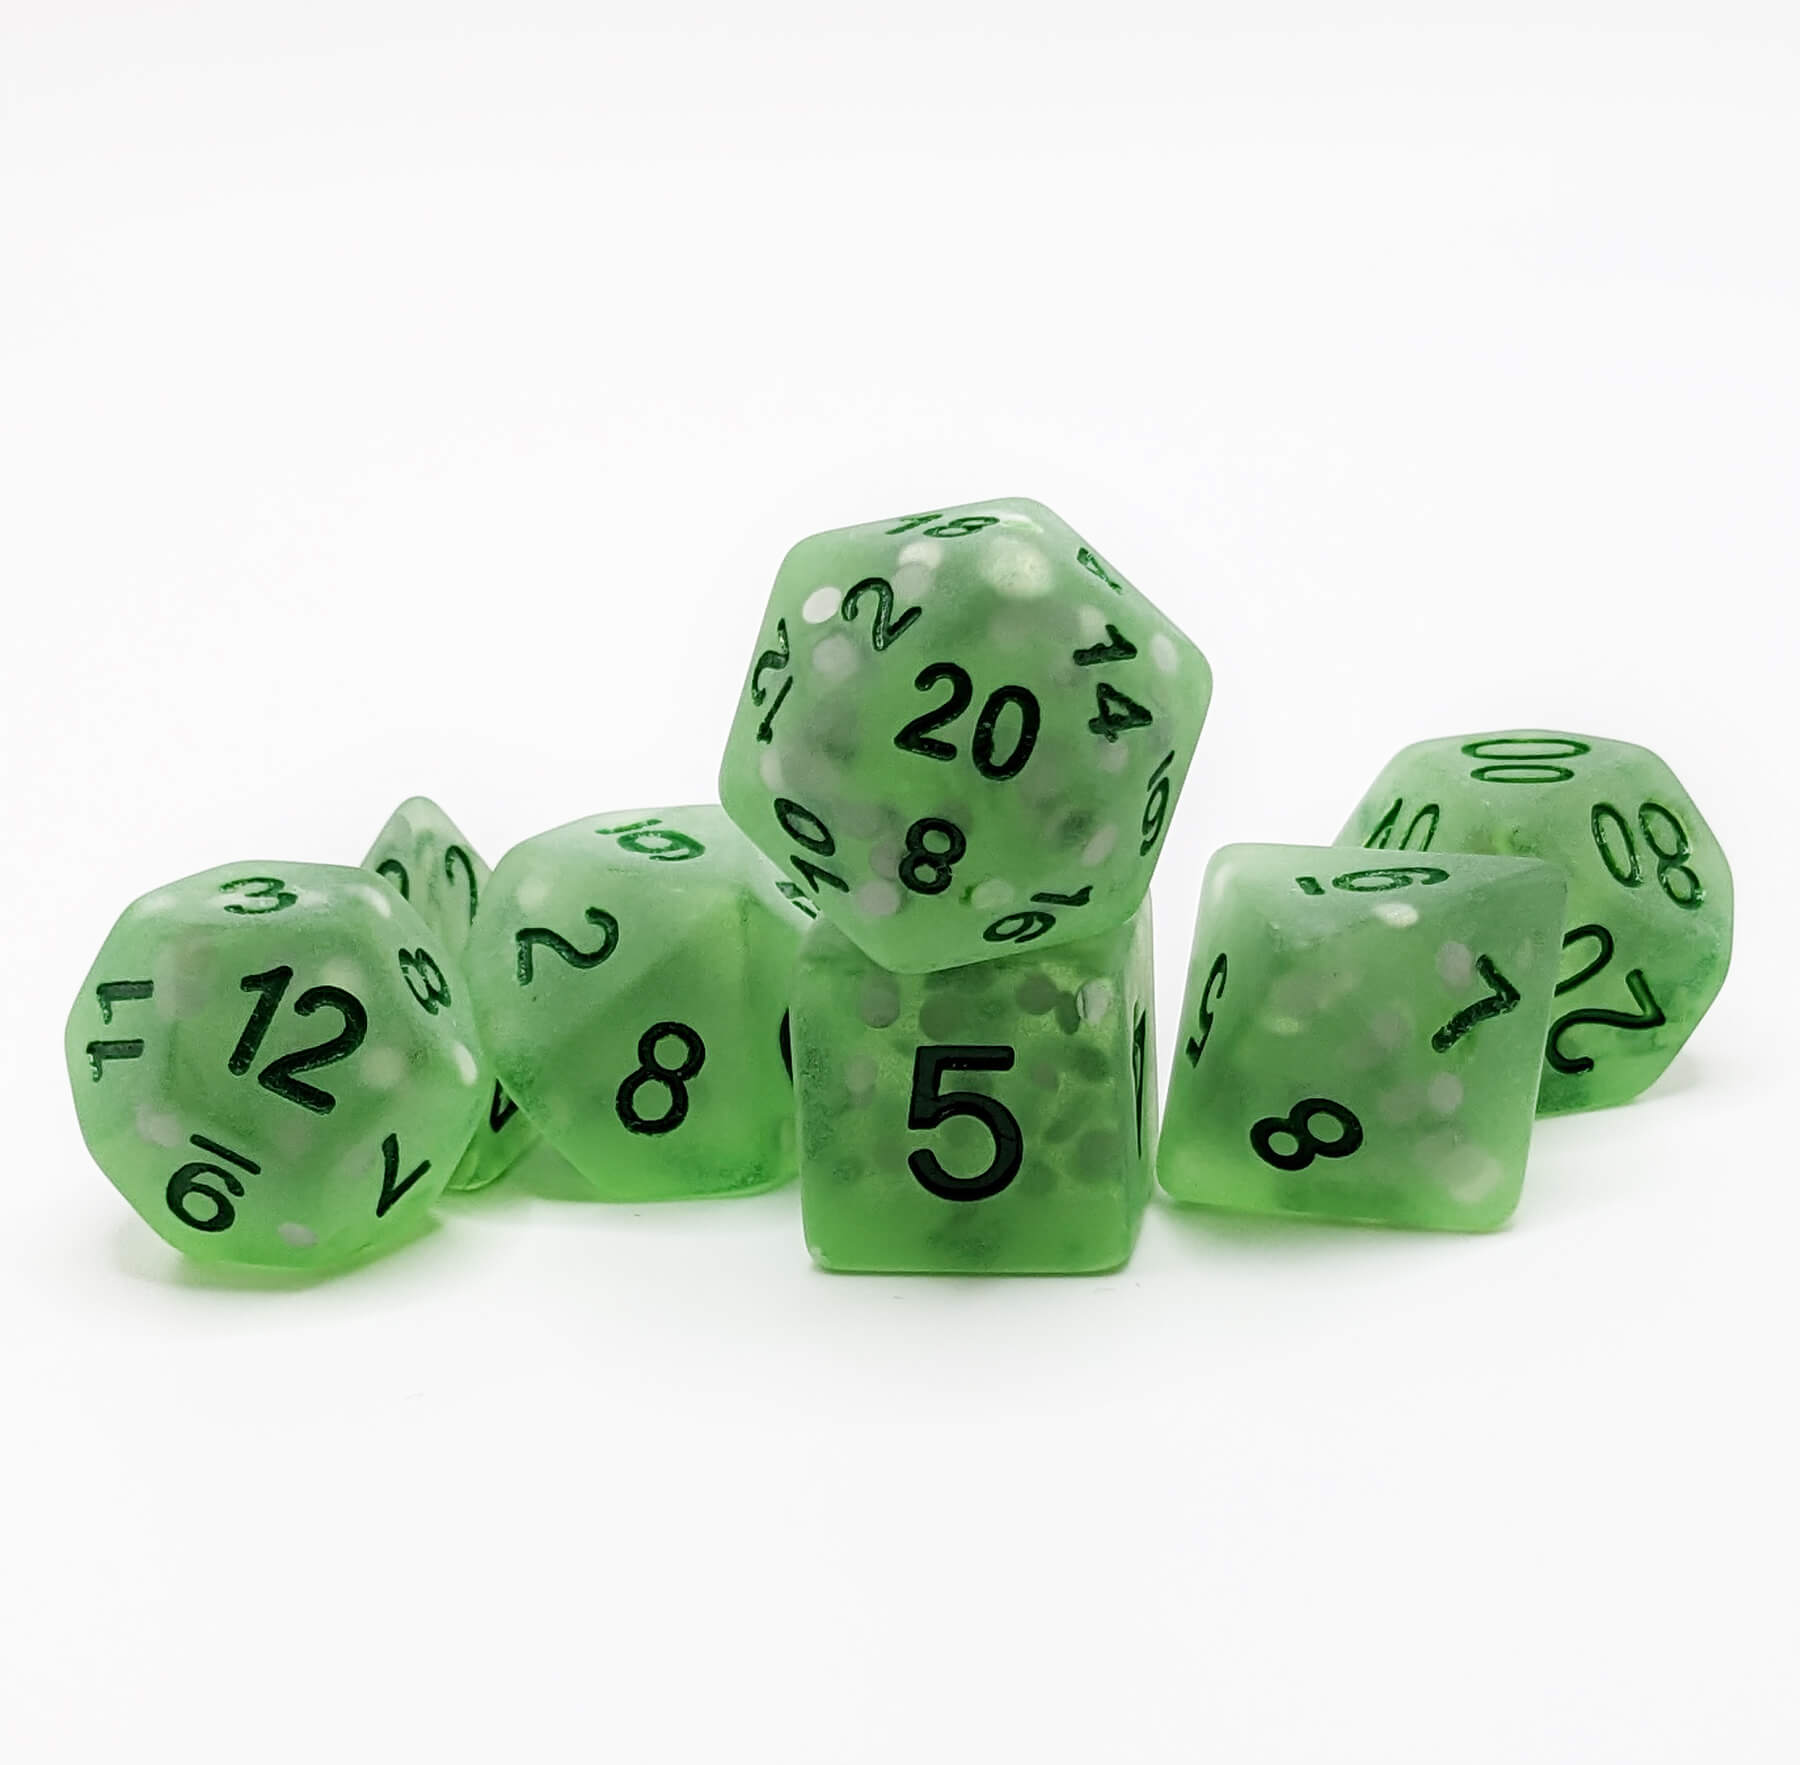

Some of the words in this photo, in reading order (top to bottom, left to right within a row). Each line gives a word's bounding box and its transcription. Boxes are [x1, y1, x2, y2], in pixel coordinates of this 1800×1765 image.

[842, 578, 922, 650] 2
[894, 662, 1041, 781] 20
[1072, 624, 1153, 743] 14
[1462, 737, 1590, 783] 00
[772, 798, 850, 893] 10
[898, 816, 966, 894] 8
[1592, 802, 1704, 909] 80
[218, 876, 298, 915] 3
[399, 947, 451, 1015] 8
[516, 907, 618, 986] 2
[86, 979, 154, 1082] 11
[227, 965, 368, 1115] 12
[1430, 954, 1522, 1053] 7
[615, 1021, 705, 1135] 8
[907, 1044, 1024, 1202] 5
[1249, 1098, 1364, 1171] 8
